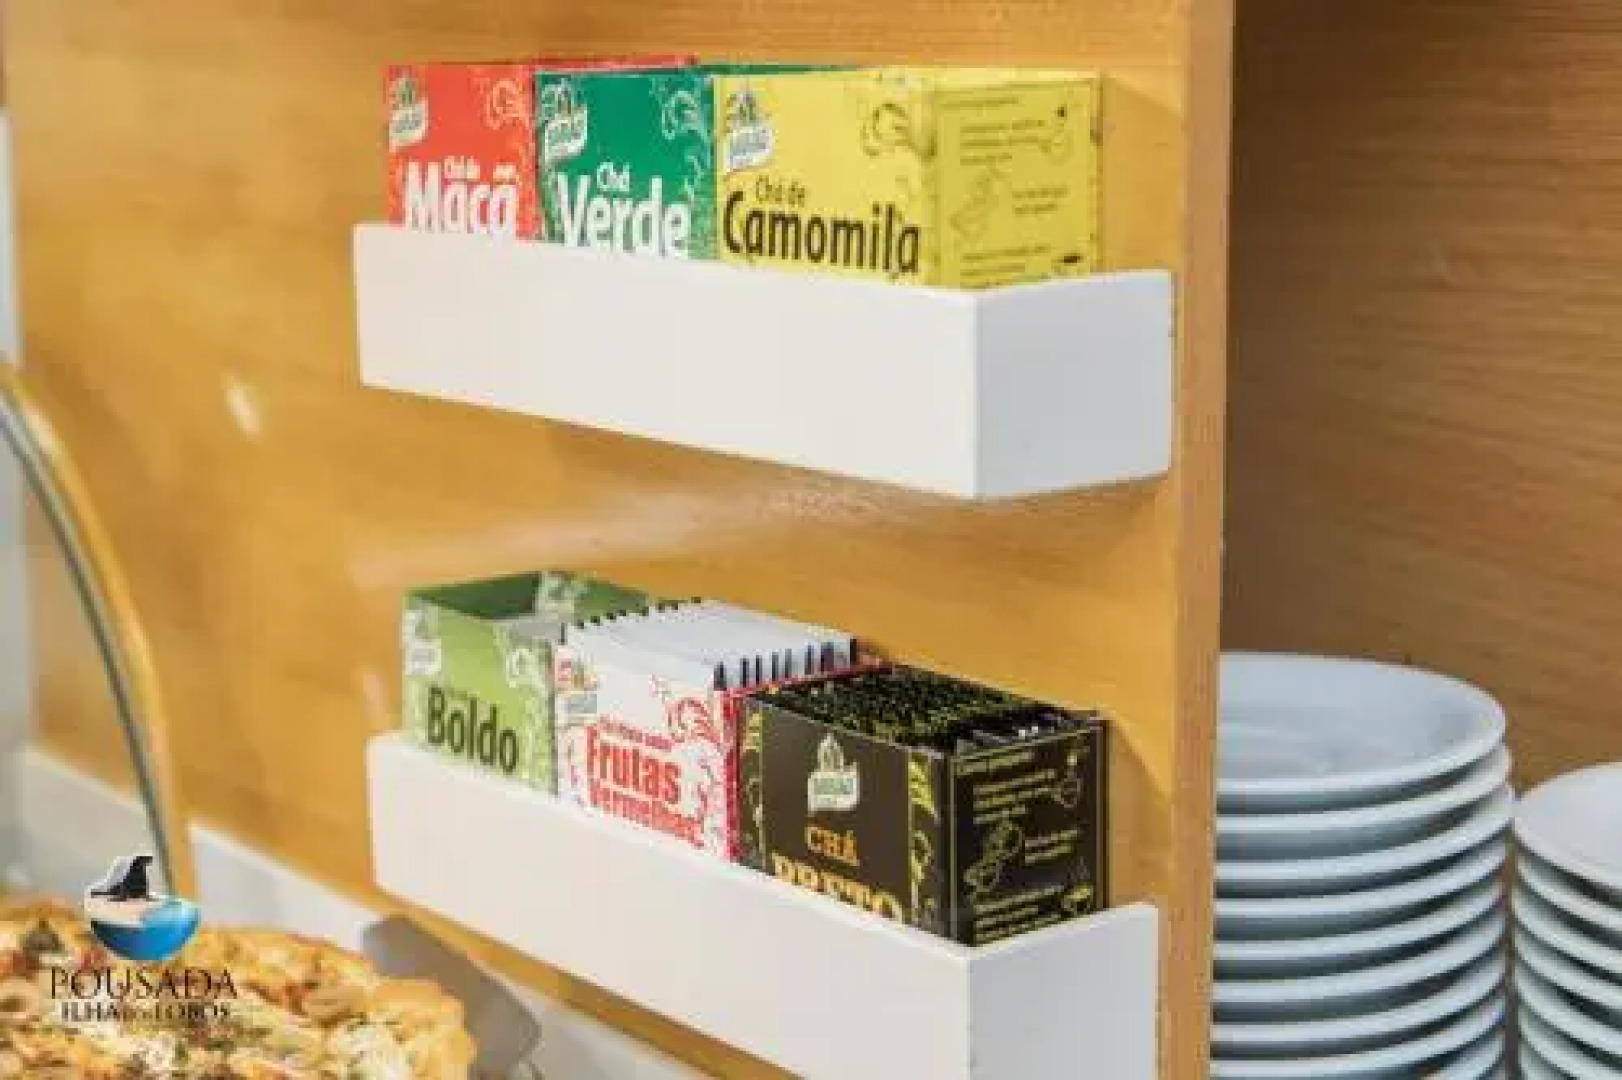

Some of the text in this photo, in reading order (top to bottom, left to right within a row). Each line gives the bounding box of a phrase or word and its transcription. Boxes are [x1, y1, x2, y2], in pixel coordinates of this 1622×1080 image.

[557, 172, 691, 258] Verde
[597, 161, 630, 191] Chá
[755, 175, 782, 203] Chá
[723, 189, 920, 273] Camomila
[427, 686, 518, 774] Boldo
[586, 726, 682, 806] Frutas
[805, 822, 860, 867] CHÁ
